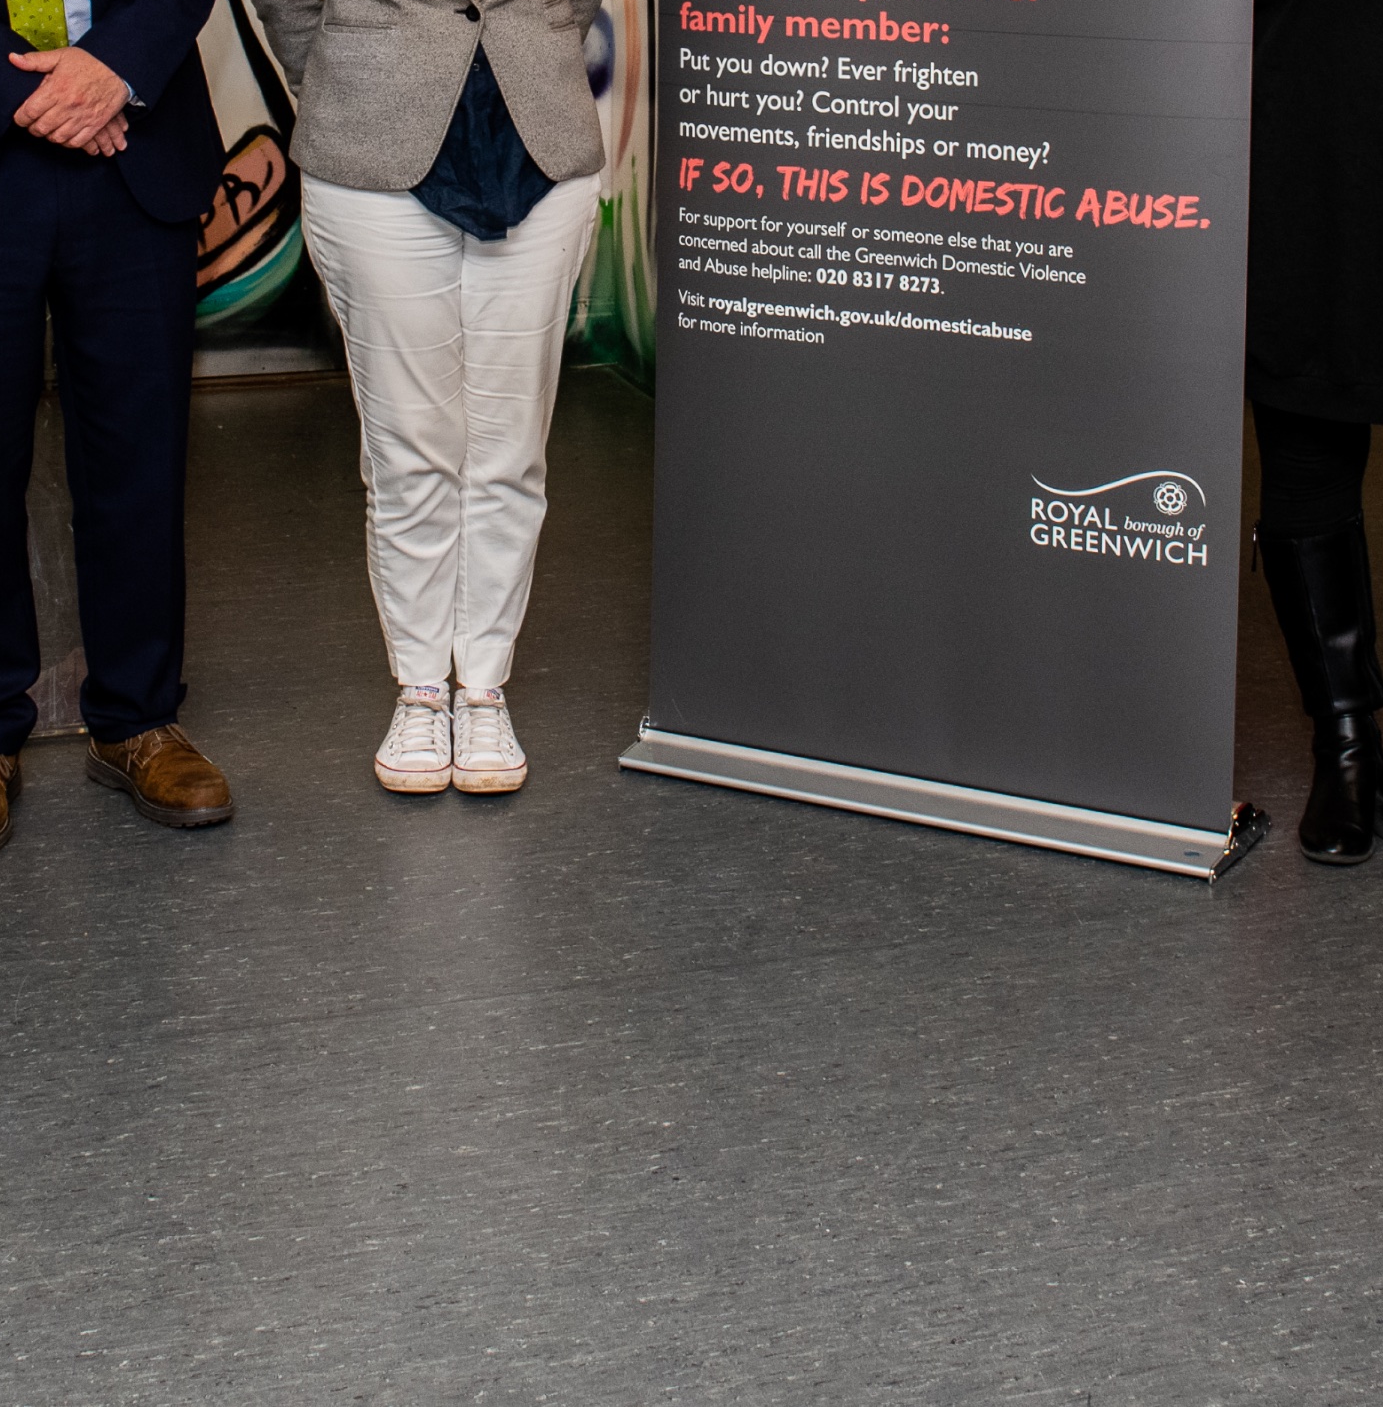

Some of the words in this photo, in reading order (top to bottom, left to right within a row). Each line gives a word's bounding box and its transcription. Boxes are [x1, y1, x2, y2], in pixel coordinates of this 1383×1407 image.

[679, 1, 775, 44] family
[785, 10, 950, 44] member:
[680, 47, 711, 72] Put
[715, 56, 753, 79] you
[759, 53, 830, 79] down?
[837, 56, 888, 82] Ever
[892, 59, 979, 91] frighten
[679, 87, 701, 104] or
[706, 83, 750, 109] hurt
[755, 89, 805, 116] you?
[811, 90, 900, 118] Control
[906, 102, 959, 125] your
[679, 121, 800, 150] movements,
[806, 124, 926, 160] friendships
[932, 139, 960, 157] or
[966, 141, 1051, 170] money?
[679, 157, 705, 192] IF
[712, 160, 764, 199] SO,
[776, 165, 850, 203] THIS
[860, 171, 891, 206] IS
[900, 174, 1065, 220] DOMESTIC
[1075, 187, 1211, 230] ABUSE.
[679, 206, 701, 224] For
[703, 214, 758, 233] support
[760, 215, 784, 233] for
[786, 221, 848, 238] yourself
[851, 227, 870, 239] or
[873, 228, 944, 246] someone
[947, 231, 978, 249] else
[980, 233, 1012, 253] that
[1014, 241, 1044, 258] you
[1048, 244, 1074, 259] are
[678, 234, 748, 253] concerned
[751, 239, 795, 258] about
[797, 243, 822, 260] call
[825, 245, 851, 262] the
[854, 246, 938, 270] Greenwich
[942, 254, 1016, 278] Domestic
[1018, 261, 1087, 285] Violence
[678, 256, 701, 273] and
[703, 258, 748, 277] Abuse
[751, 262, 812, 284] helpline:
[815, 267, 848, 286] 020
[852, 270, 895, 290] 8317
[898, 274, 945, 295] 8273.
[677, 311, 698, 329] for
[699, 319, 737, 335] more
[740, 321, 825, 344] information
[678, 288, 706, 308] Visit
[708, 296, 1033, 342] royalgreenwich.gov.uk/domesticabuse
[1031, 497, 1118, 530] ROYAL
[1124, 516, 1184, 538] borough
[1187, 524, 1206, 541] of
[1030, 523, 1208, 567] GREENWICH
